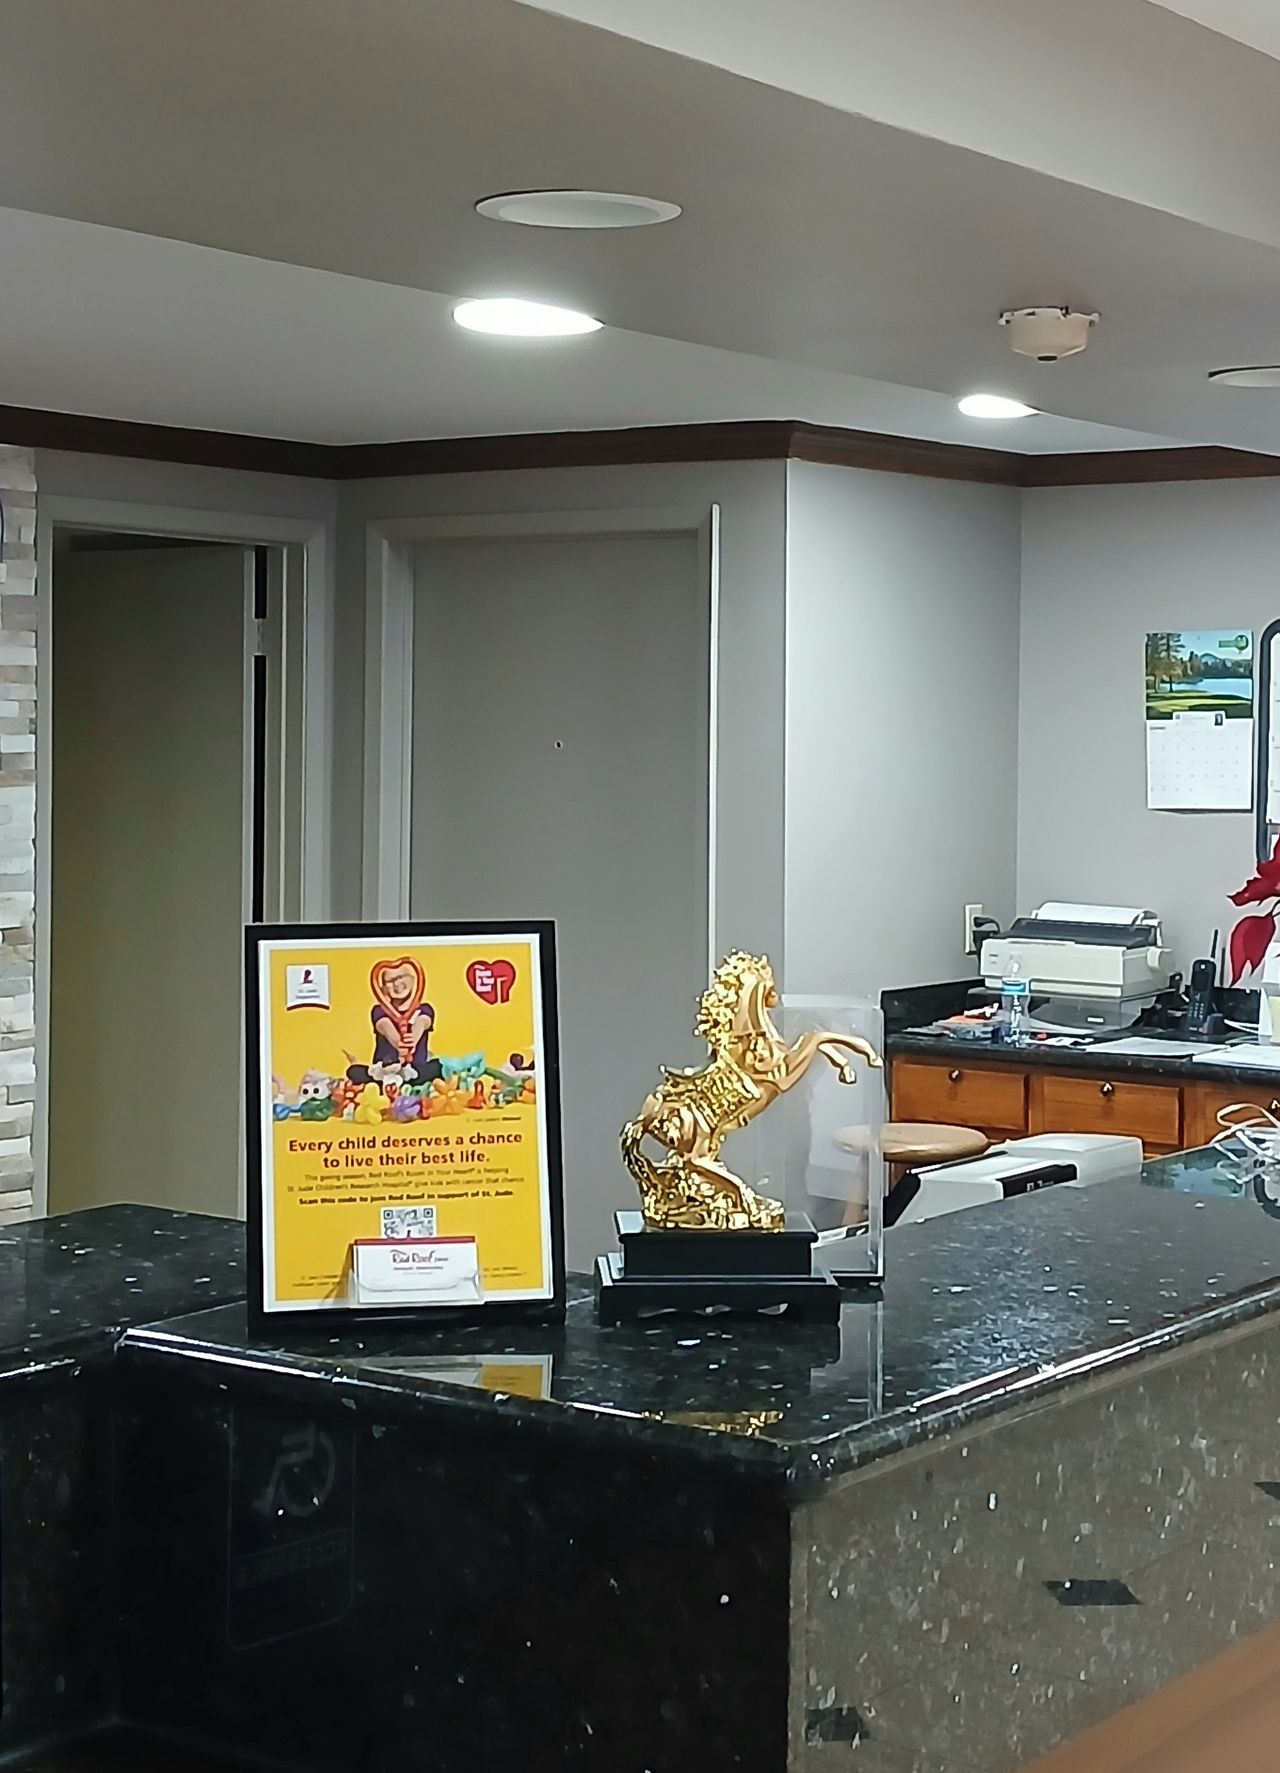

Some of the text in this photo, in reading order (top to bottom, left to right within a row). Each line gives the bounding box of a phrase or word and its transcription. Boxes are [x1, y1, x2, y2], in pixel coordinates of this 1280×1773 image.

[289, 1132, 522, 1154] Every child deserves a chance
[323, 1150, 490, 1168] to live their best life.
